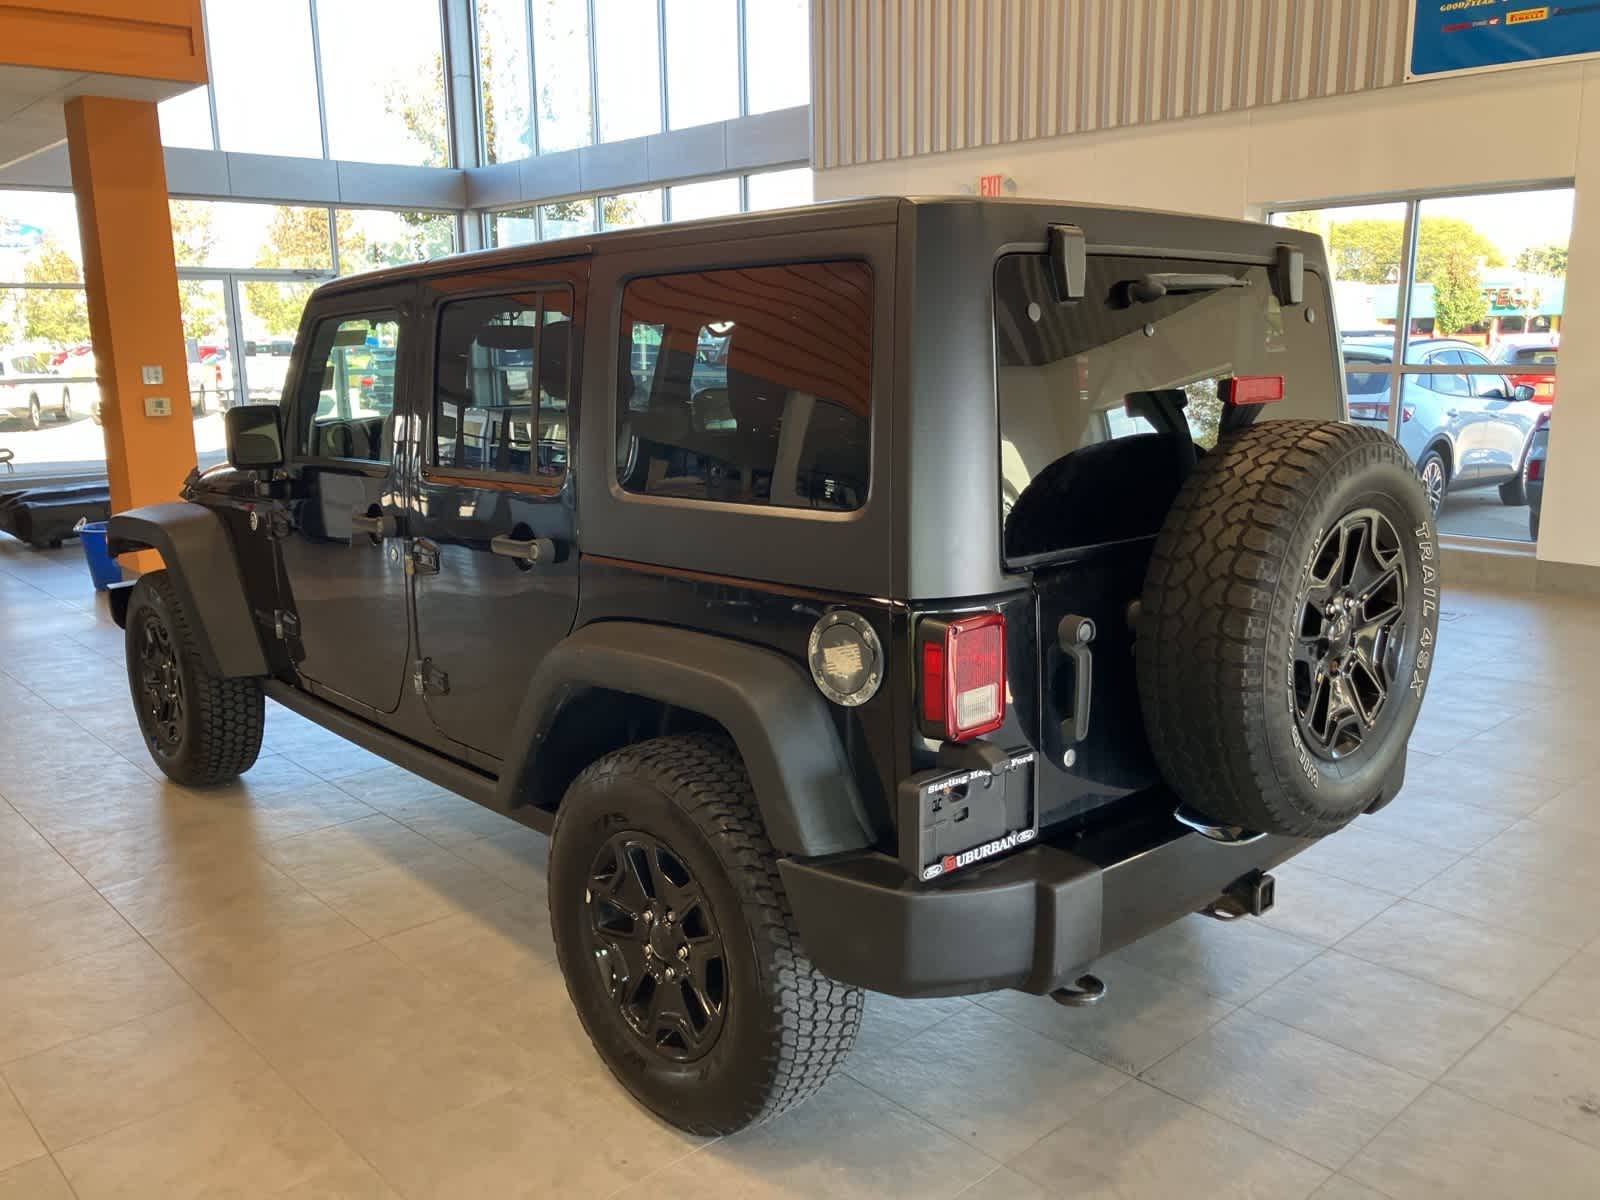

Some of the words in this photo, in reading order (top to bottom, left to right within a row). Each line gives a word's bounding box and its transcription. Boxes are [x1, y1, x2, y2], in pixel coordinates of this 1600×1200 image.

[980, 175, 1002, 197] EXIT
[1415, 521, 1437, 617] TRAIL
[1011, 754, 1033, 767] Ford
[944, 835, 1016, 872] SUBURBAN
